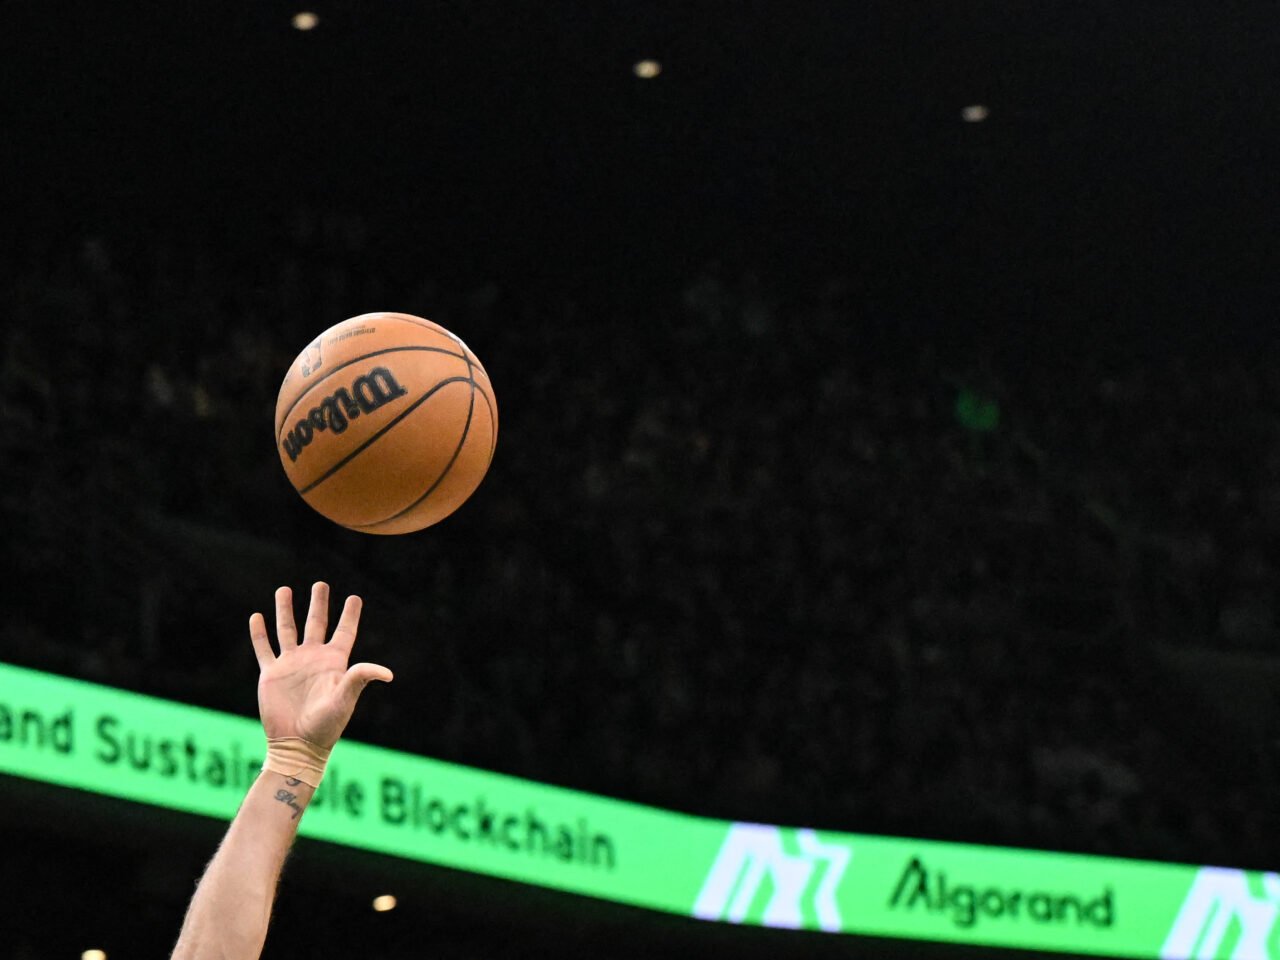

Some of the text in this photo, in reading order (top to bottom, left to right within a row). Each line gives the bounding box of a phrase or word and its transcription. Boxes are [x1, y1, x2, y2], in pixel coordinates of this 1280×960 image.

[282, 365, 408, 462] Wilson
[96, 714, 365, 818] Sustaile
[381, 776, 615, 867] Blockchain
[890, 857, 1114, 928] Algorand
